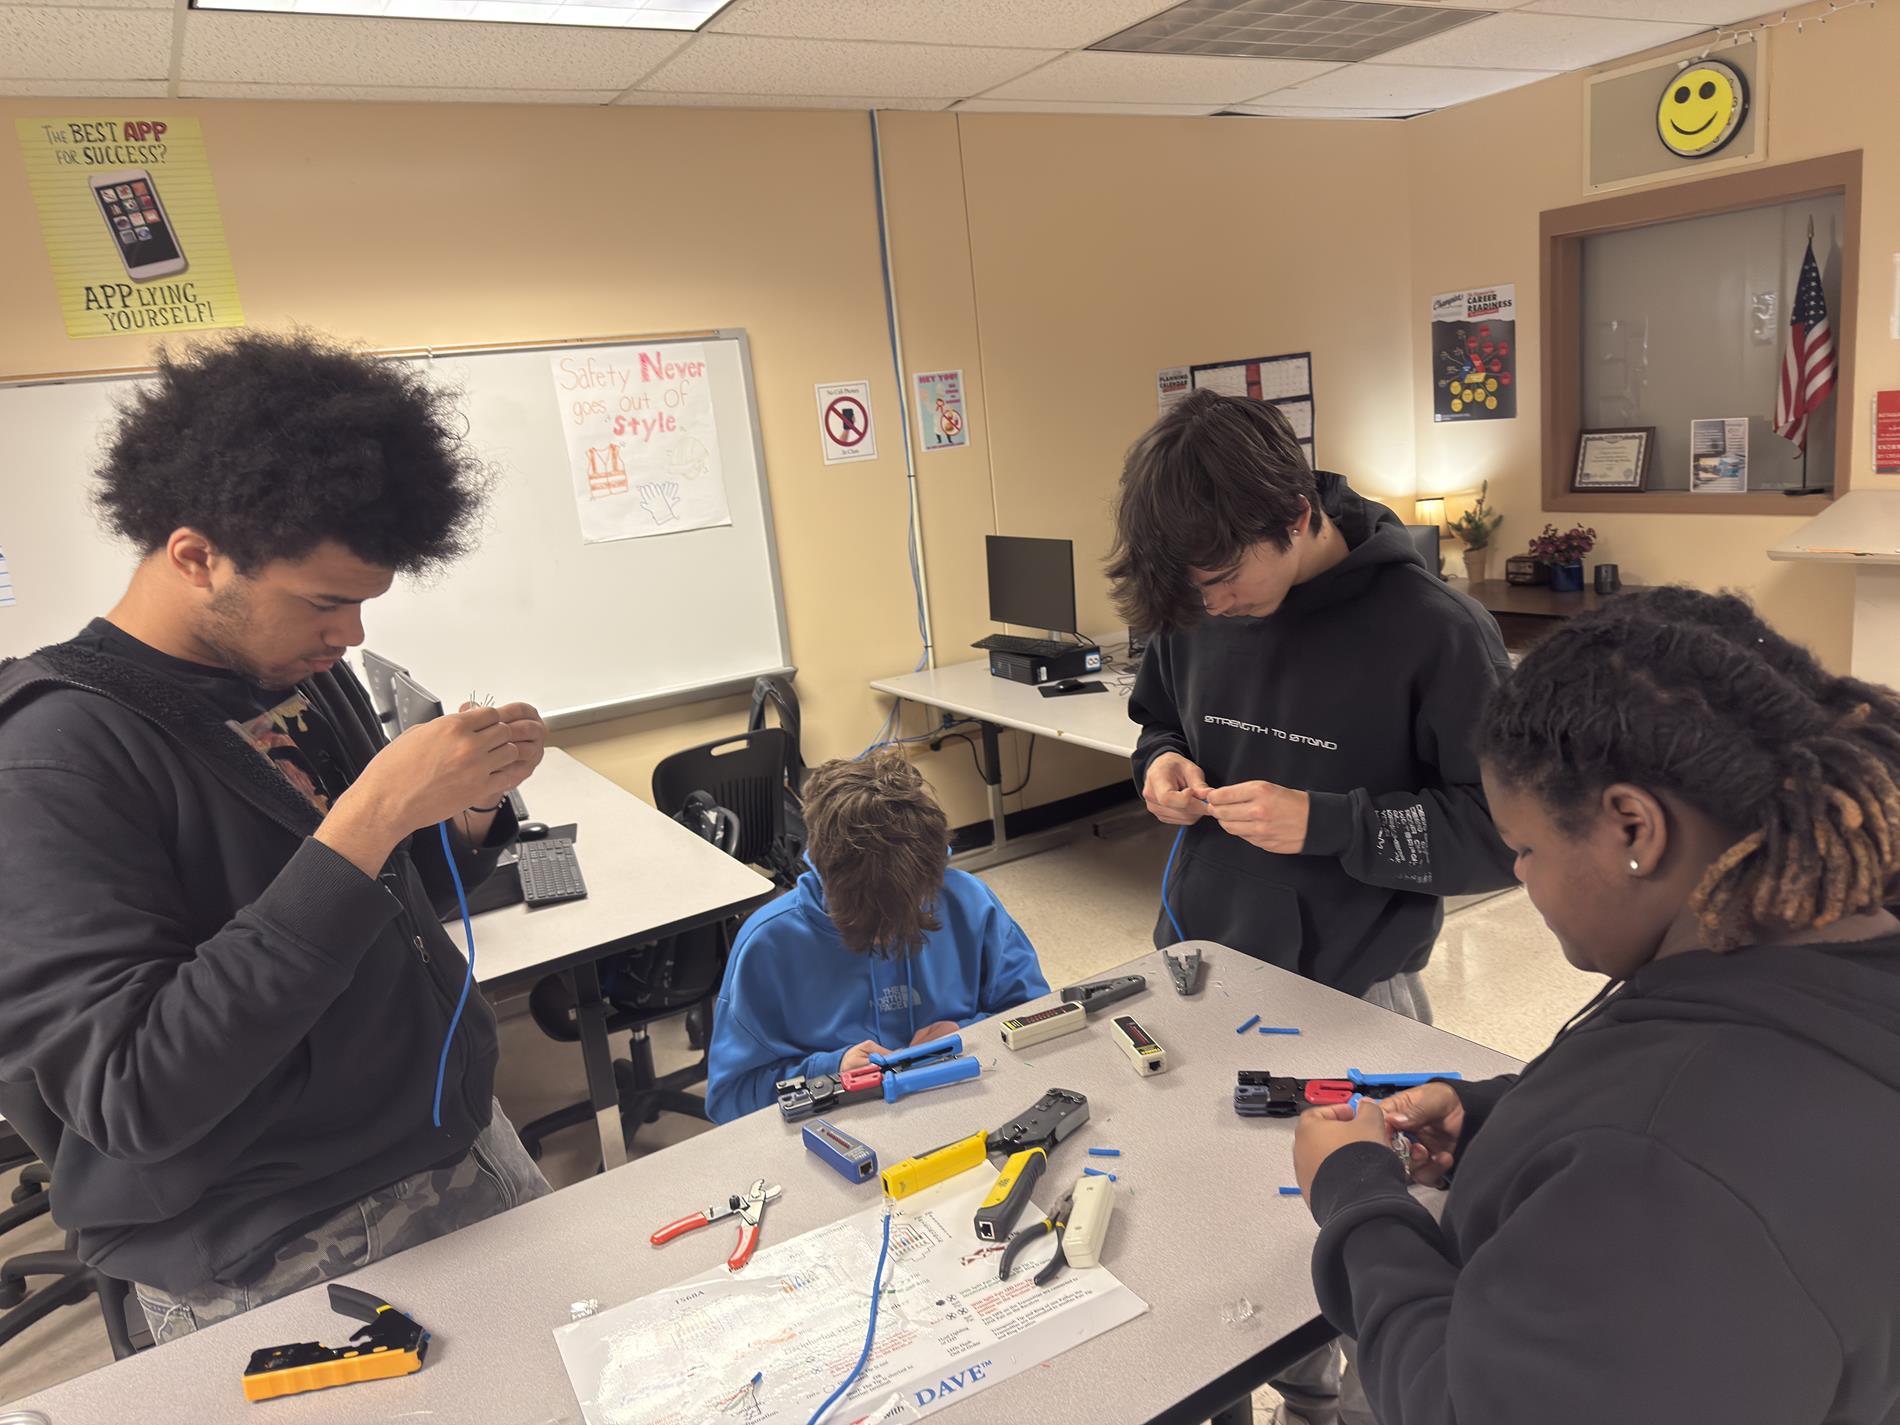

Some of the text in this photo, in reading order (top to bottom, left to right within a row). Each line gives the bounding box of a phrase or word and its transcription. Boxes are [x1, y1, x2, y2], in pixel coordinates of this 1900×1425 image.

[68, 121, 118, 144] BEST
[124, 120, 167, 142] APP
[83, 144, 167, 166] SUCCESS?
[1467, 294, 1497, 304] CAREER
[1467, 300, 1513, 313] READINESS
[103, 301, 215, 331] YOURSELF!
[560, 351, 705, 393] Safety Never
[572, 399, 607, 426] goes
[619, 391, 651, 413] out
[1271, 728, 1287, 739] TO
